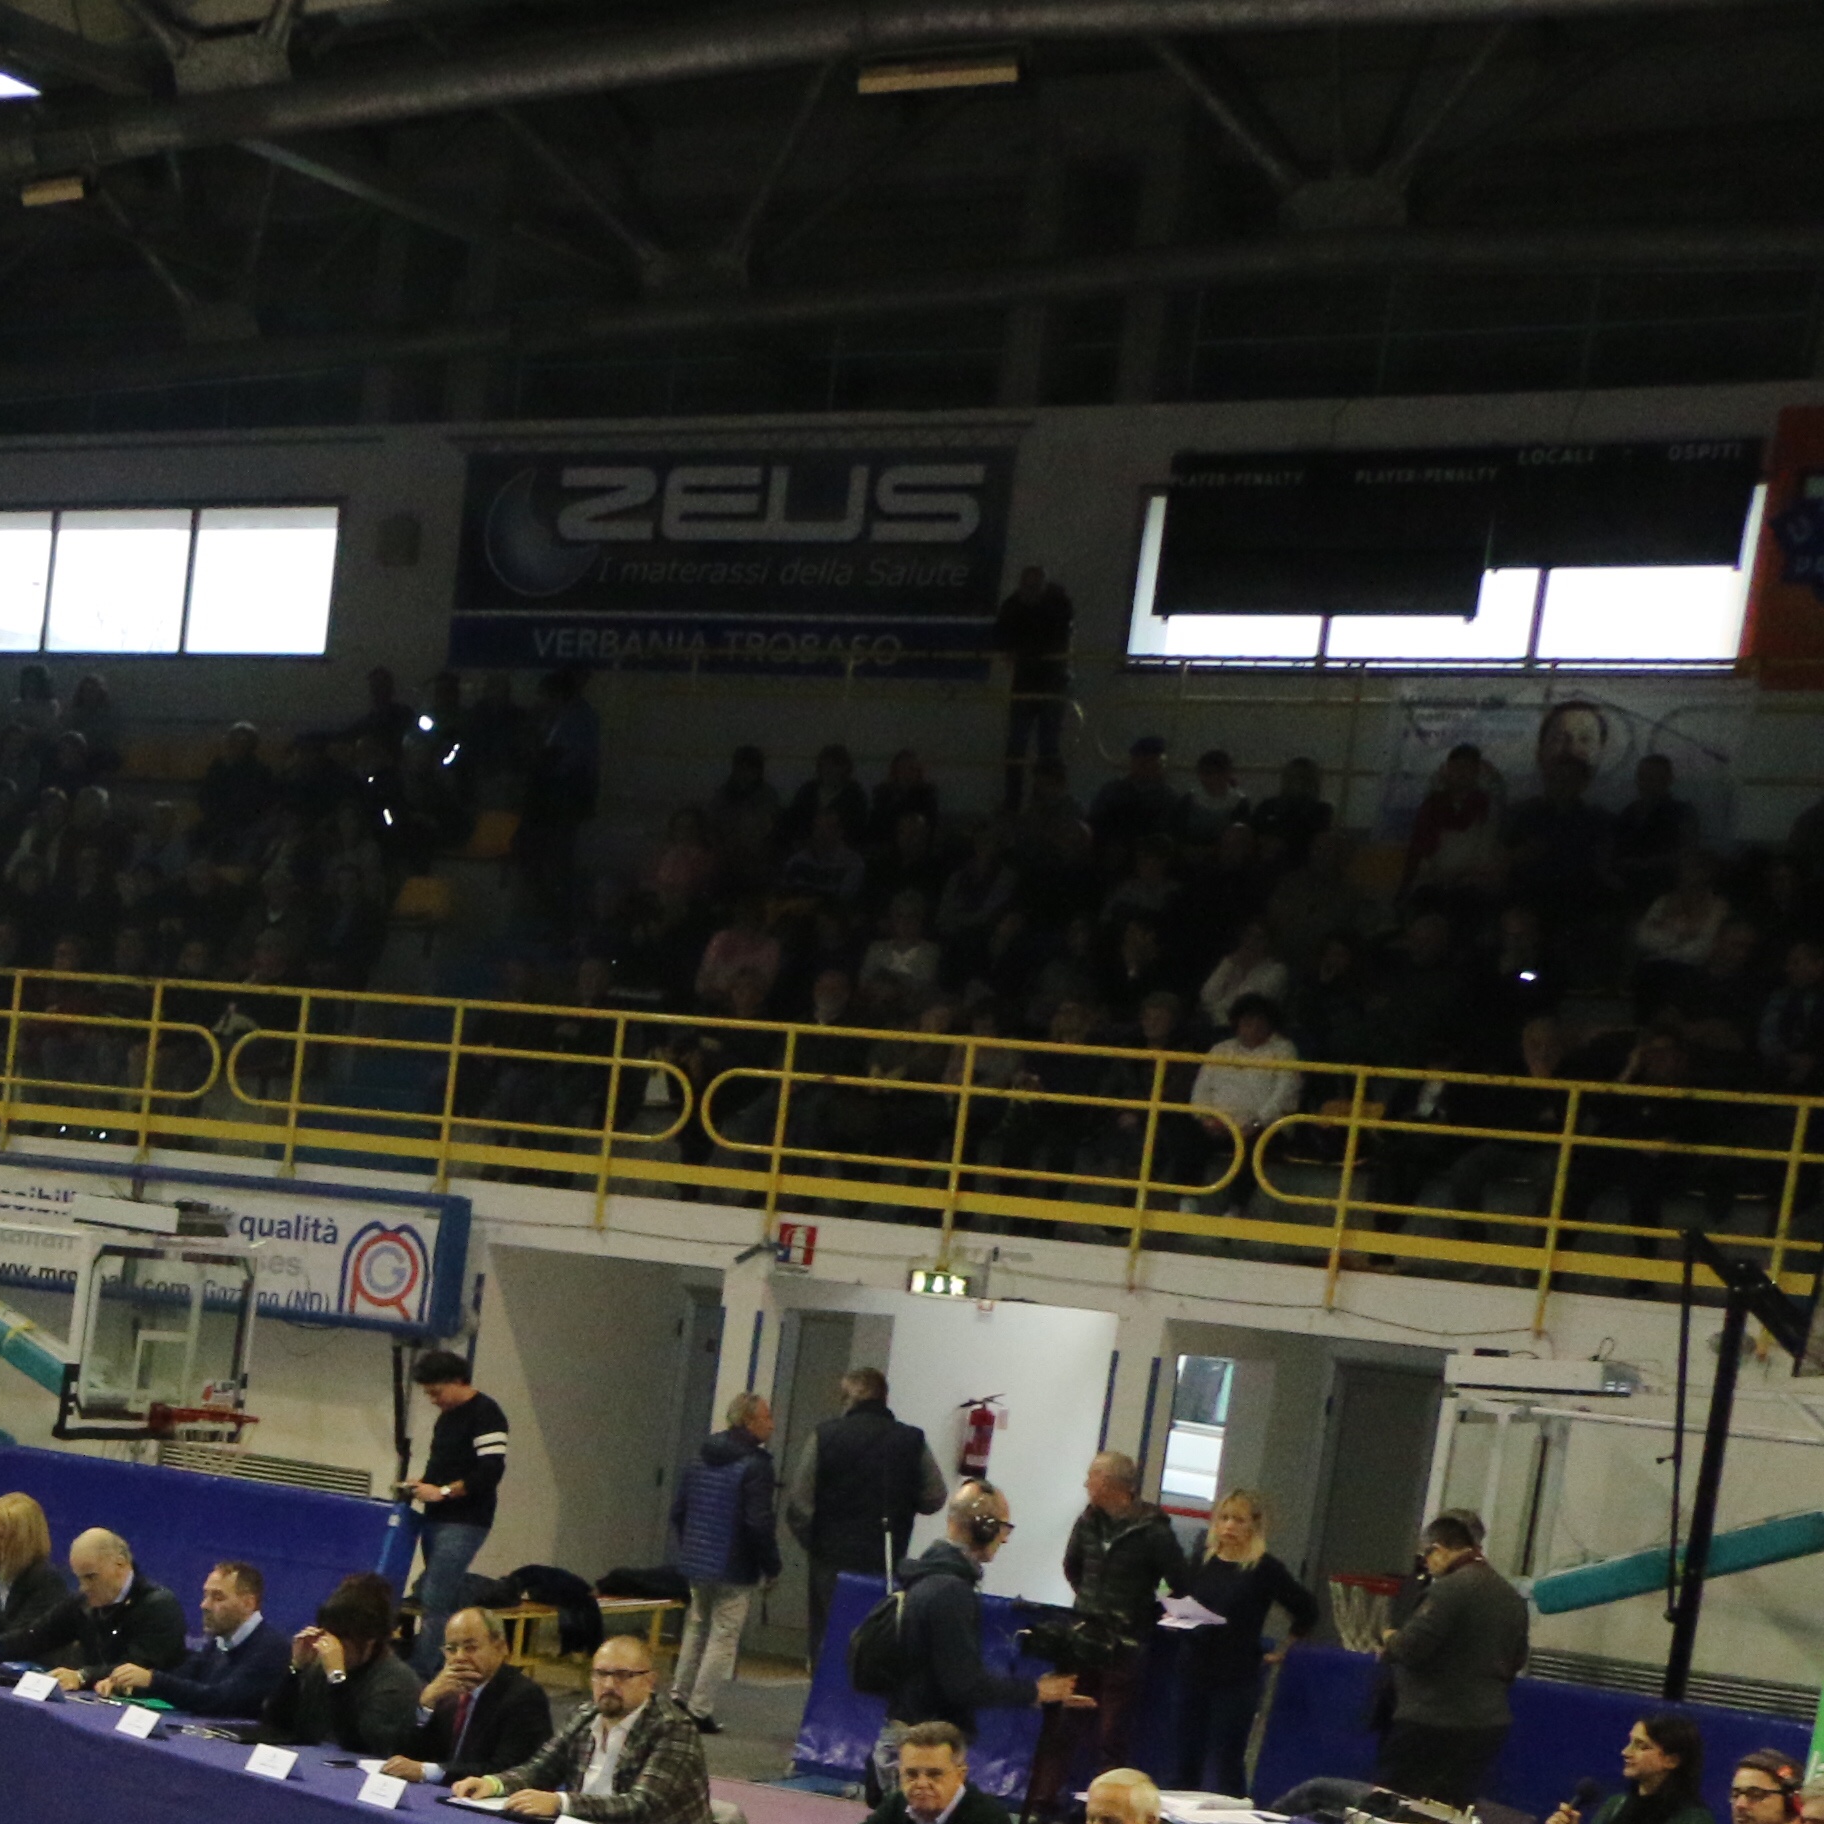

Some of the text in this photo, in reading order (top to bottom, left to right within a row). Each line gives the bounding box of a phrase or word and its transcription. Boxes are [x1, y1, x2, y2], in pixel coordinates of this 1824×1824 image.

[1667, 442, 1743, 462] OSPITI
[556, 463, 987, 543] ZEUS
[619, 559, 770, 586] materassi
[778, 556, 854, 587] della
[864, 557, 970, 589] Salute
[532, 627, 903, 665] VERBANIA TROBASO
[238, 1213, 340, 1246] qualità
